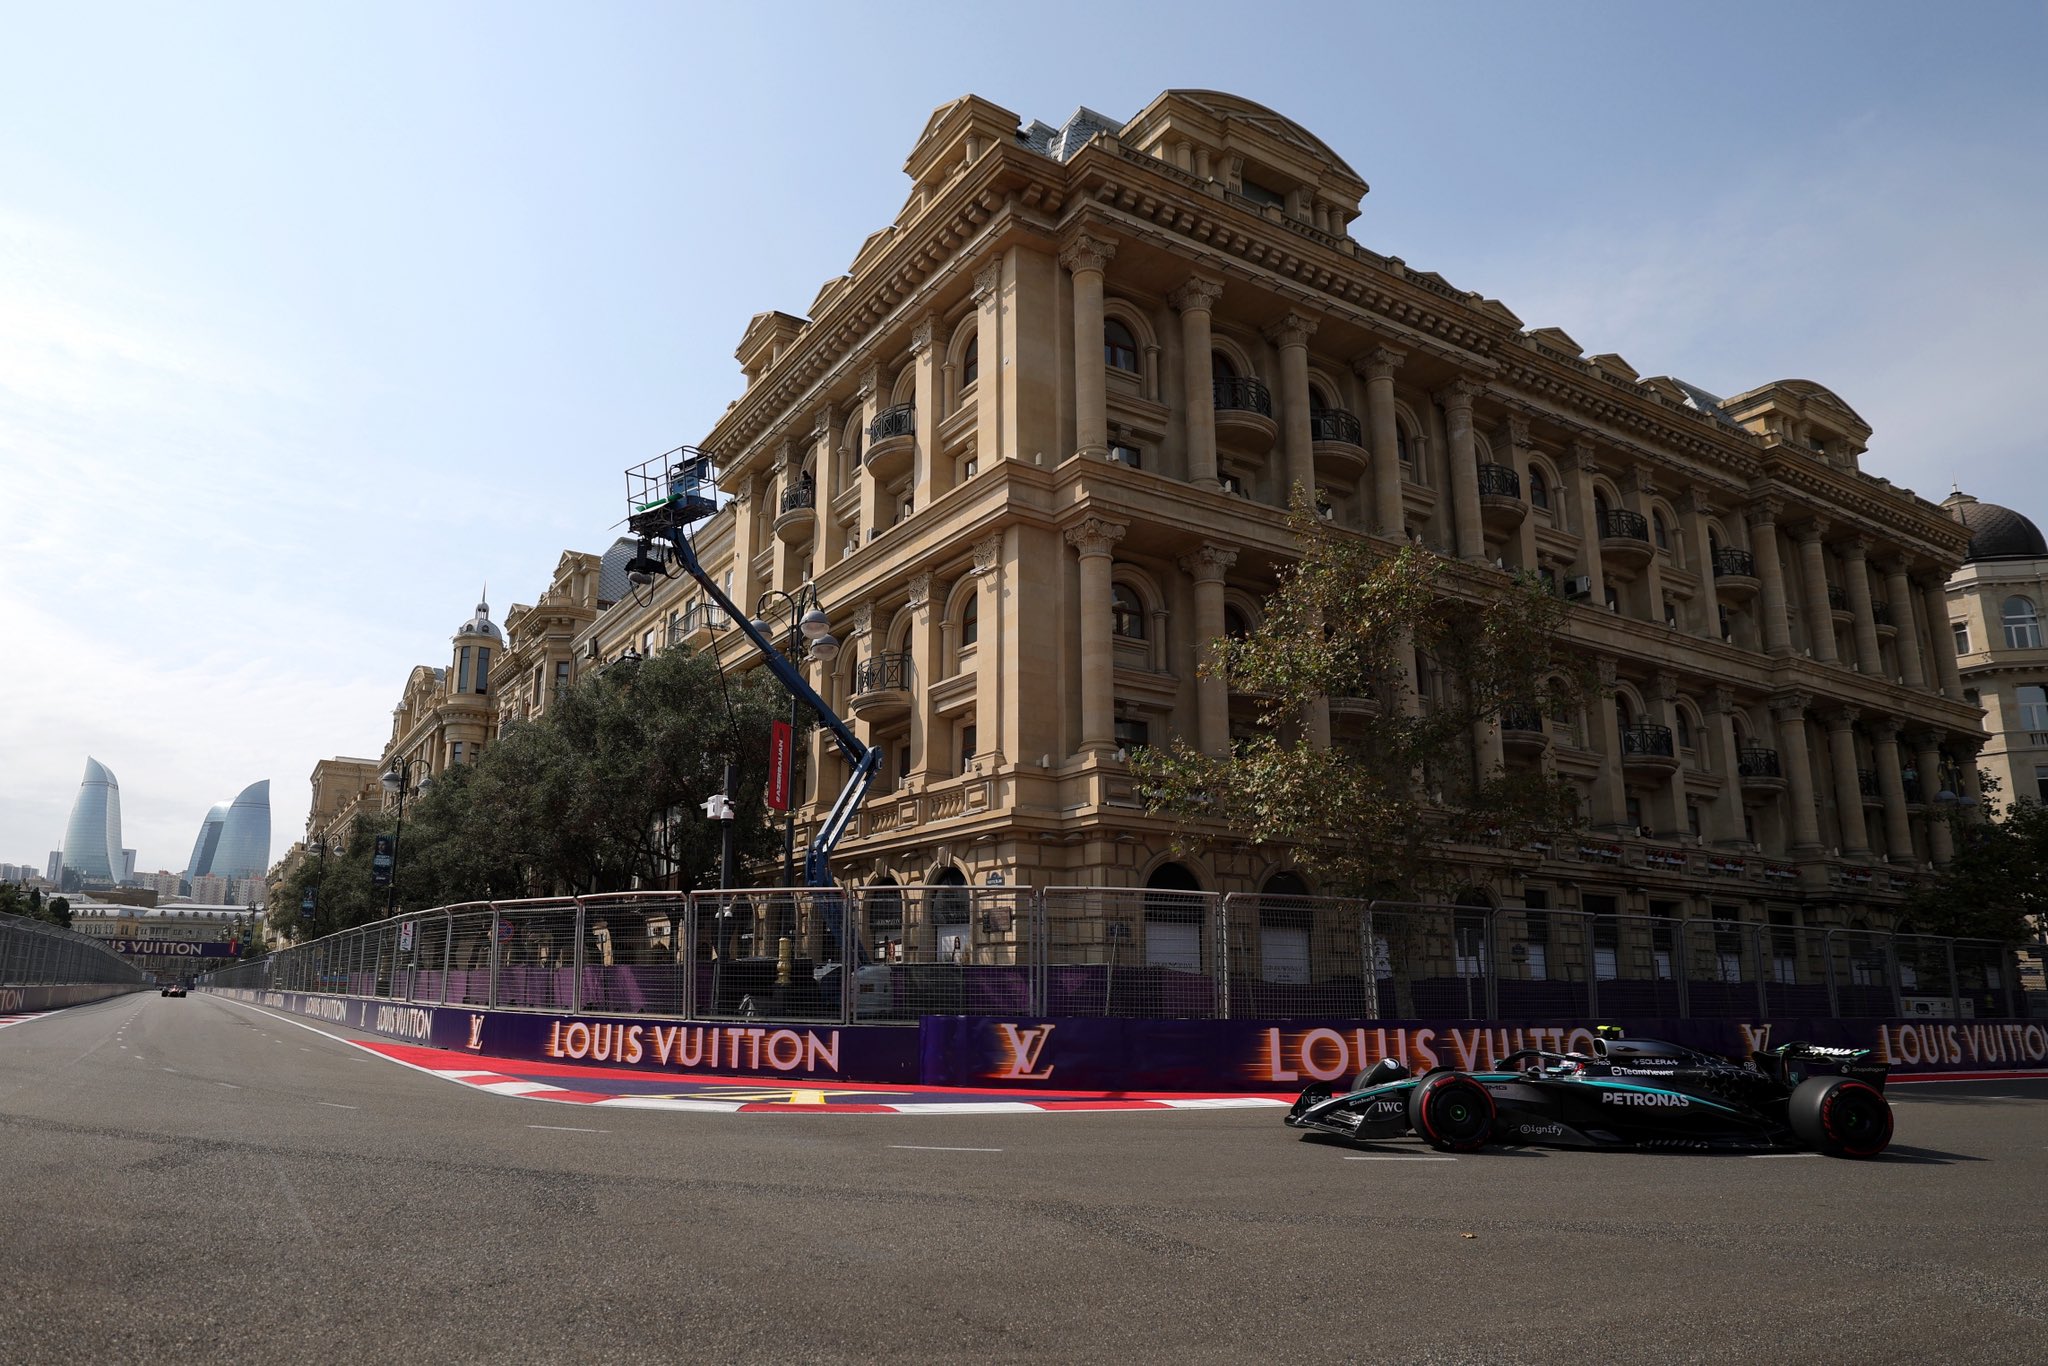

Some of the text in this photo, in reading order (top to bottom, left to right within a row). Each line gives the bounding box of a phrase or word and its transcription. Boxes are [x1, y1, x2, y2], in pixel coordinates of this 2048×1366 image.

[775, 739, 784, 803] #AZERBAIJAN
[131, 941, 203, 955] VUITTON
[321, 997, 348, 1021] VUITTON
[376, 1005, 433, 1040] LOUIS VUITTON
[552, 1021, 840, 1073] LOUIS VUITTON
[1269, 1027, 1439, 1083] LOUIS
[1882, 1024, 1962, 1065] LOUIS
[1621, 1066, 1675, 1077] TeamViewer
[1377, 1102, 1403, 1113] IWC
[1601, 1092, 1690, 1107] PETRONAS
